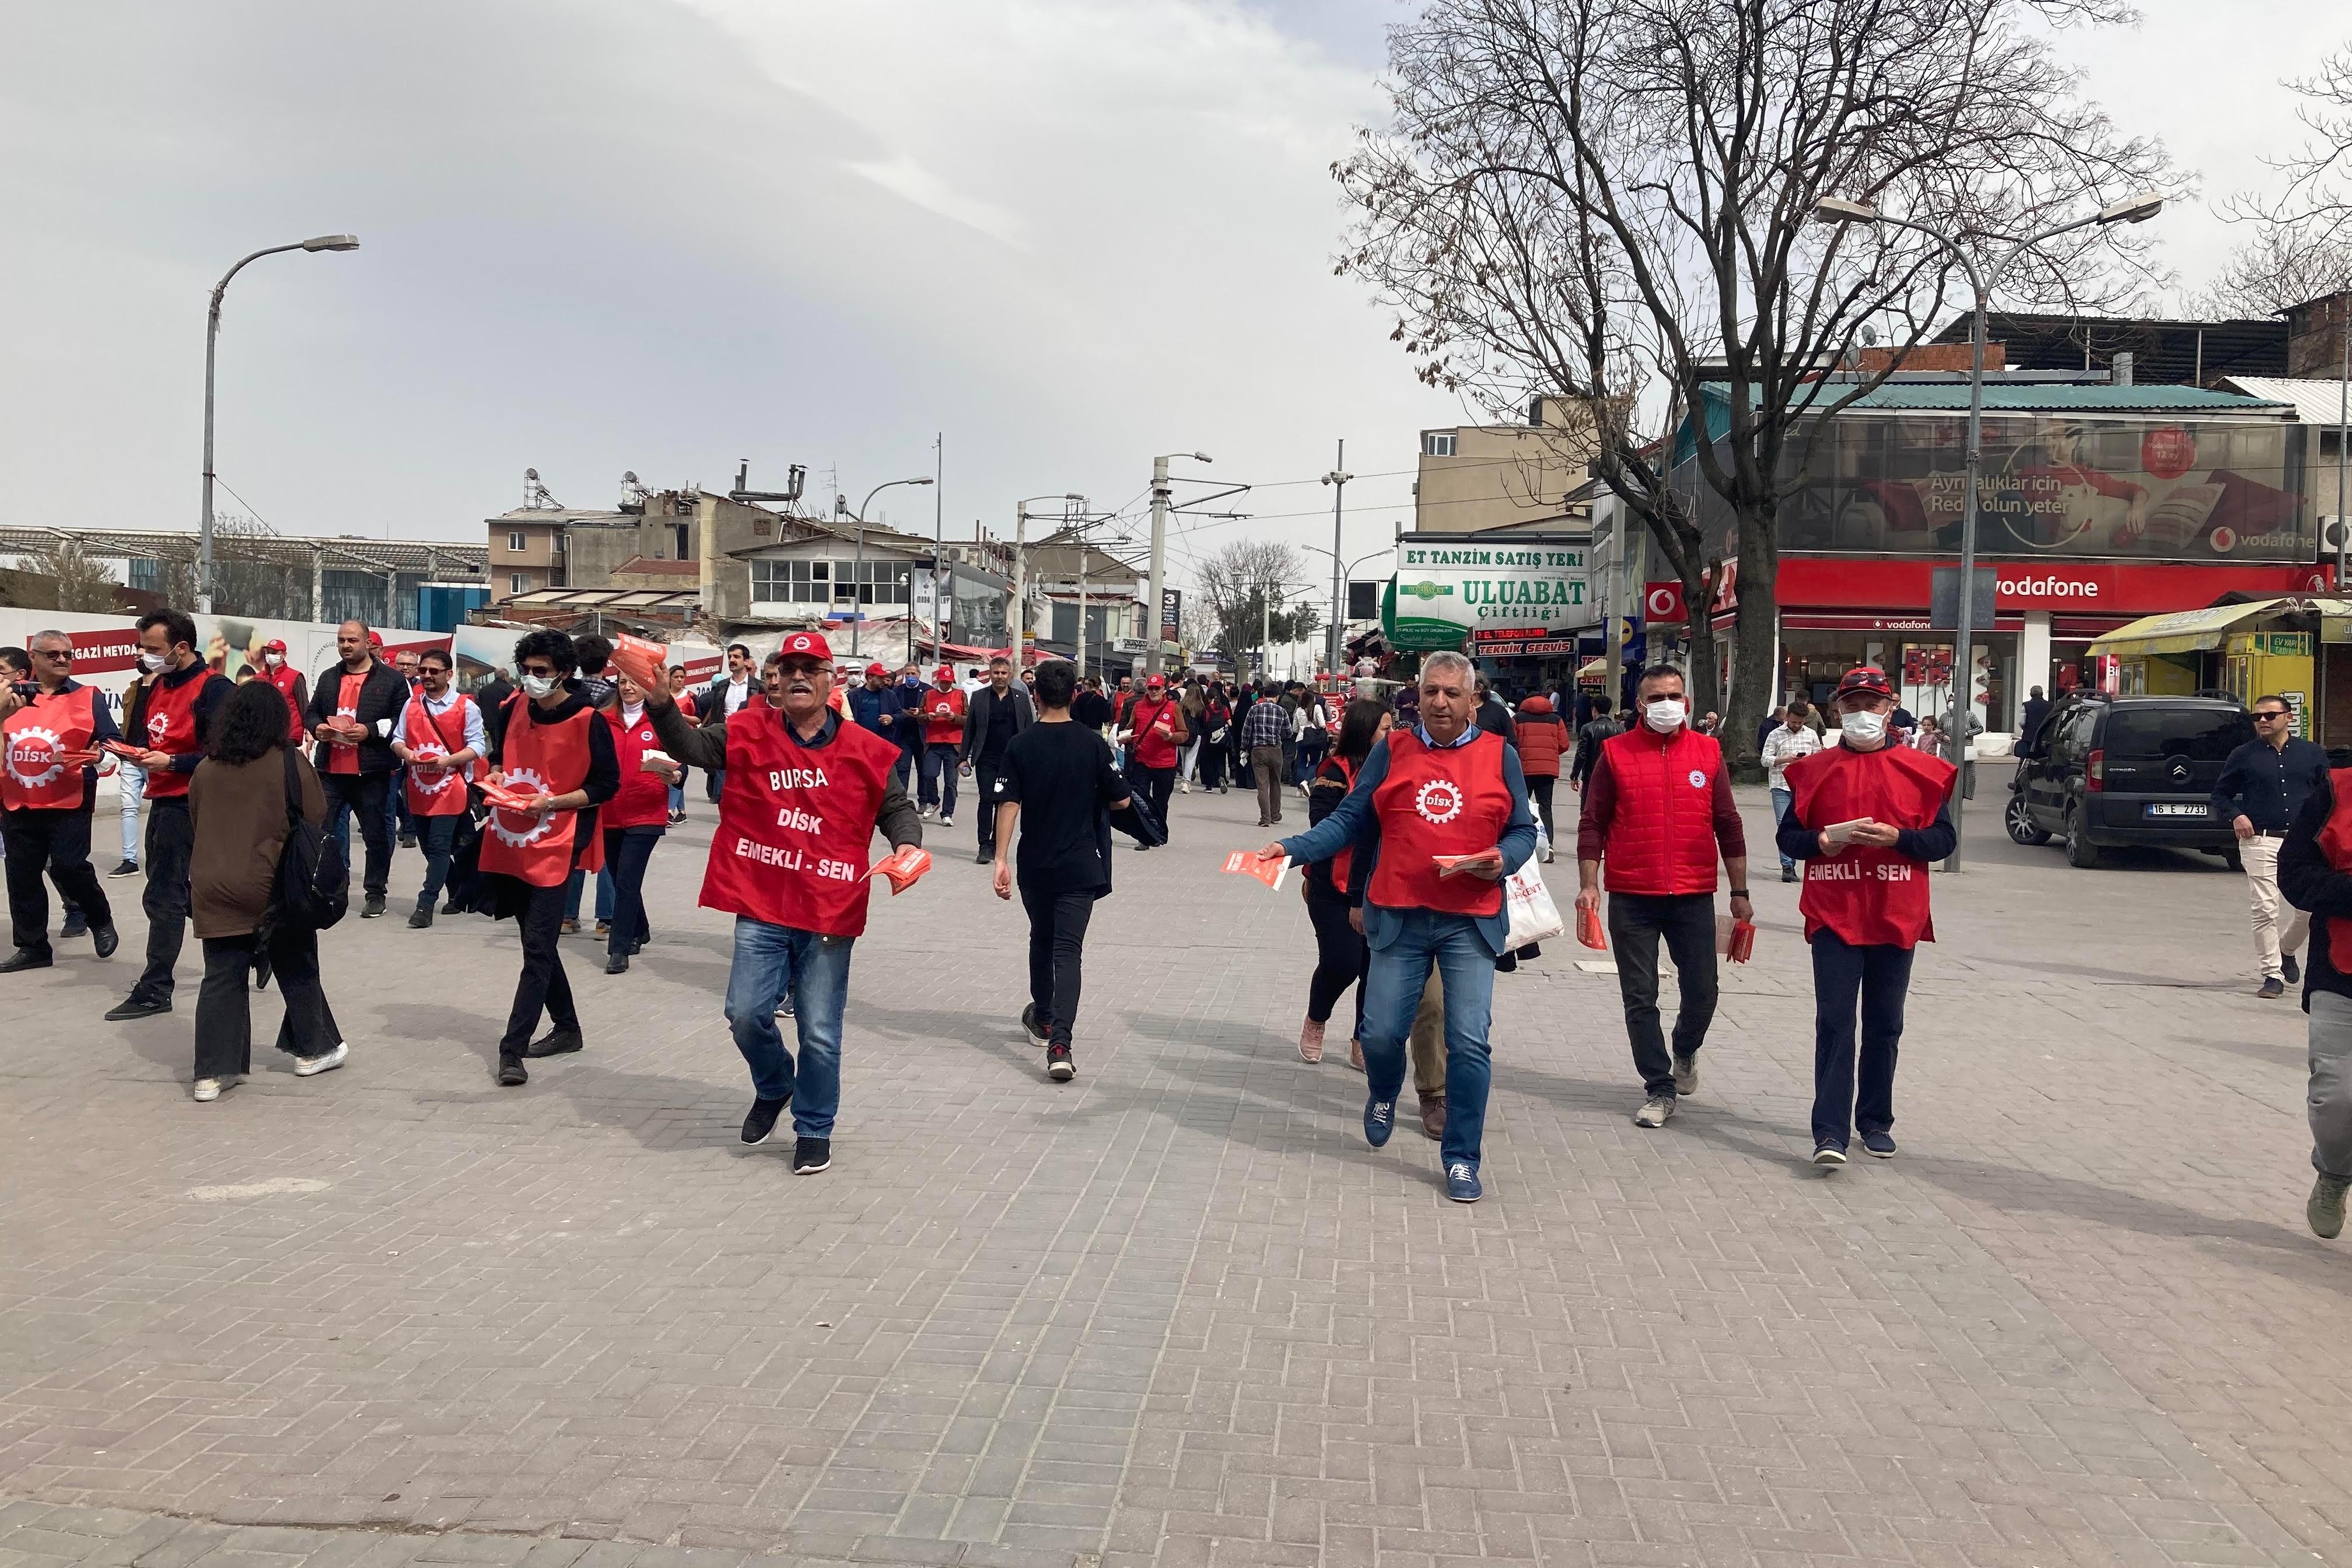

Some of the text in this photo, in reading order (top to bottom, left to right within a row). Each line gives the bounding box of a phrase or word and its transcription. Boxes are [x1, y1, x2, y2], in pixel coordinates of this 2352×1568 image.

[2169, 453, 2179, 461] ay
[1931, 474, 2062, 495] Ayrıalıklar için
[1983, 496, 2021, 512] olun
[2025, 499, 2070, 516] yeter
[2241, 533, 2315, 548] vodafone
[1406, 548, 1584, 569] ET TANZİM SATIŞ YERİ
[1164, 593, 1176, 604] 3
[1462, 580, 1586, 605] ULUABAT
[1477, 606, 1560, 620] Çiftliği
[1479, 640, 1571, 655] TEKNİK SERVİS
[13, 746, 53, 763] DİSK
[769, 767, 829, 791] BURSA
[1426, 793, 1453, 807] DİSK
[2154, 804, 2206, 814] 16 E 2733
[776, 807, 823, 835] DİSK
[736, 838, 803, 871] EMEKLİ
[817, 859, 855, 882] SEN
[1808, 859, 1861, 881] EMEKLİ
[1877, 864, 1911, 881] SEN
